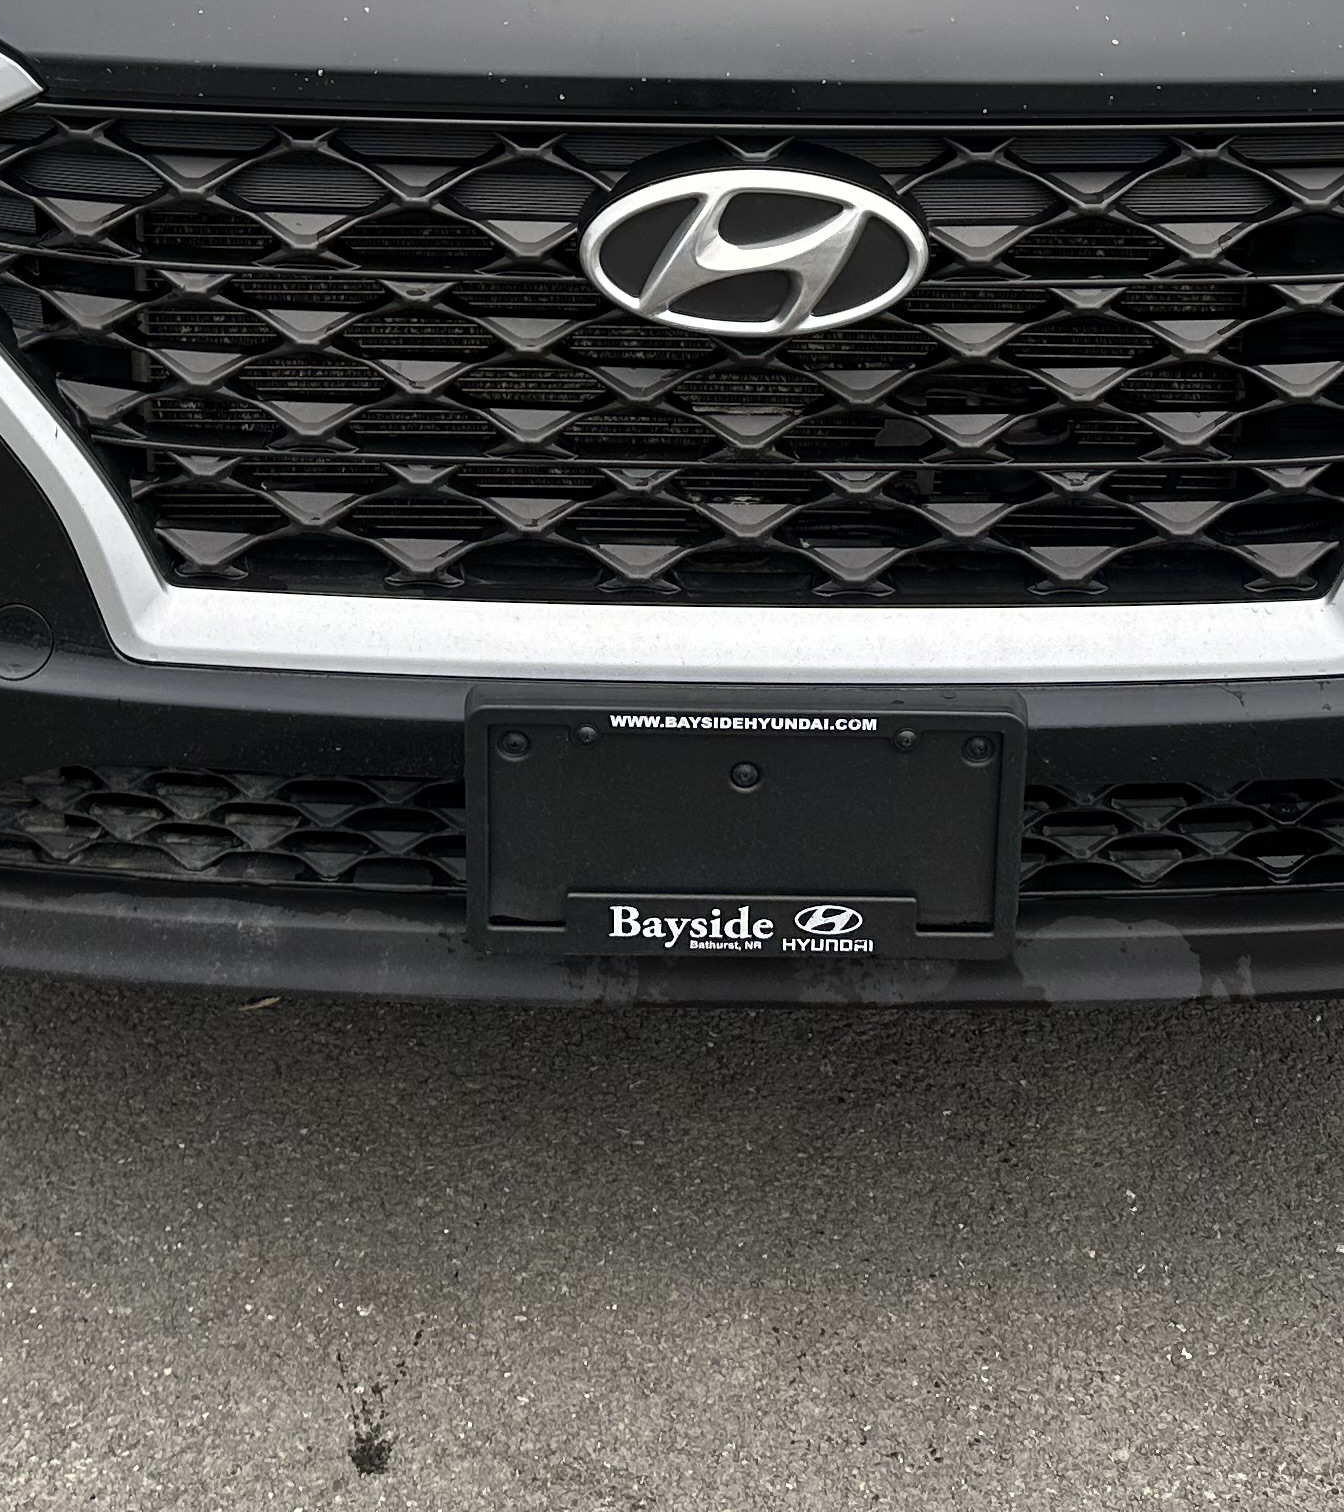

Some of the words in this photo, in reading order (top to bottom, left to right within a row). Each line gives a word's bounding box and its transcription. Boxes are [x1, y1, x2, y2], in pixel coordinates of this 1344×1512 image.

[610, 715, 877, 731] WWW.BAYSIDEHYUNDAI.COM
[609, 905, 774, 948] Bayside
[689, 939, 742, 951] Bathurst,
[782, 938, 874, 952] HYUNDAI
